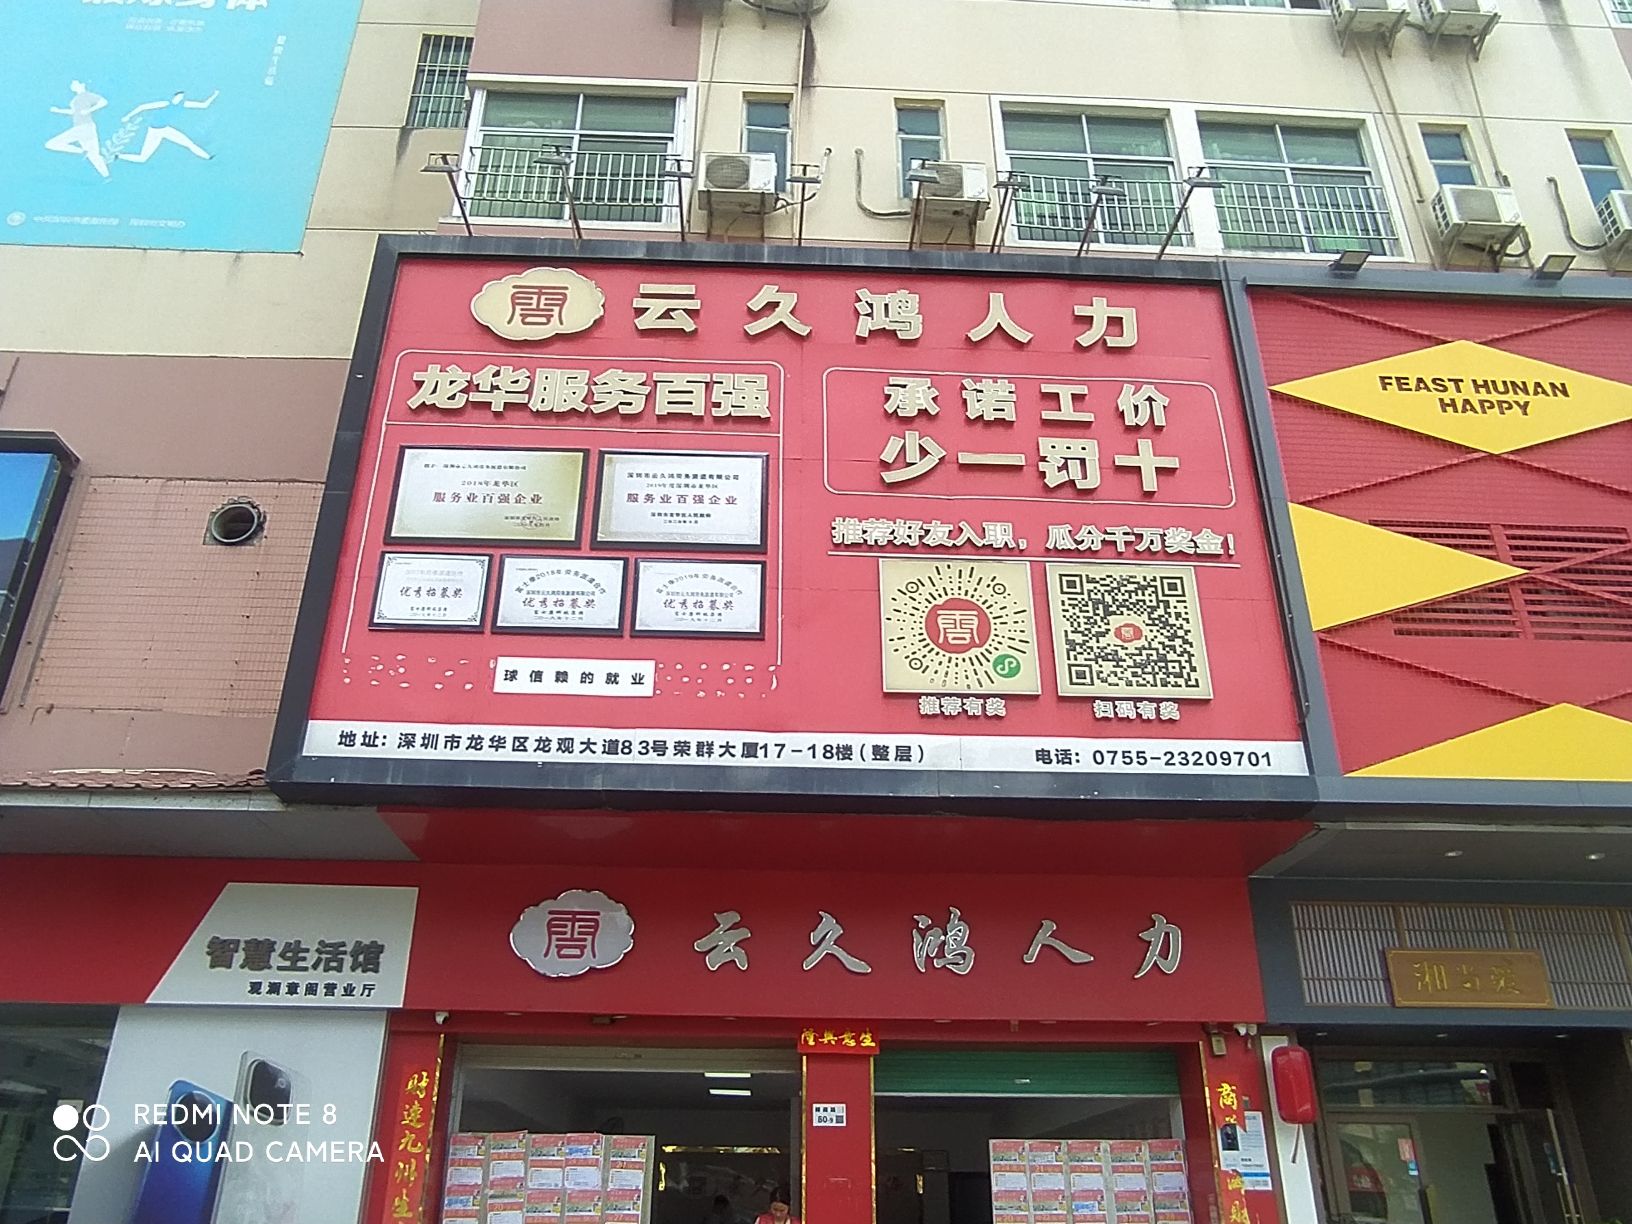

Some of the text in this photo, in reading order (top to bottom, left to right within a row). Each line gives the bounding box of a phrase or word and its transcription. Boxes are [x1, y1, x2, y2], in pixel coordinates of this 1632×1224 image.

[632, 283, 1138, 348] 云久鸿人力
[407, 364, 771, 419] 龙华服务百强
[1378, 376, 1570, 398] FEAST HUNAN
[884, 377, 1170, 428] 承诺工价
[1438, 398, 1530, 416] HAPPY
[880, 430, 1180, 492] 少一罚十
[433, 492, 543, 505] 服务业百强企业
[626, 493, 738, 506] 服务业百强企业
[400, 586, 463, 599] 优秀招募奖
[523, 597, 596, 609] 优秀招募奖
[663, 599, 735, 611] 优秀招募奖
[503, 669, 645, 685] 球信赖的就业
[919, 696, 1007, 717] 推荐有奖
[1093, 700, 1180, 721] 扫码有奖
[694, 906, 1182, 979] 云久鸿人力
[206, 935, 385, 974] 智慧生活馆
[248, 981, 376, 998] 观澜章阁营业厅
